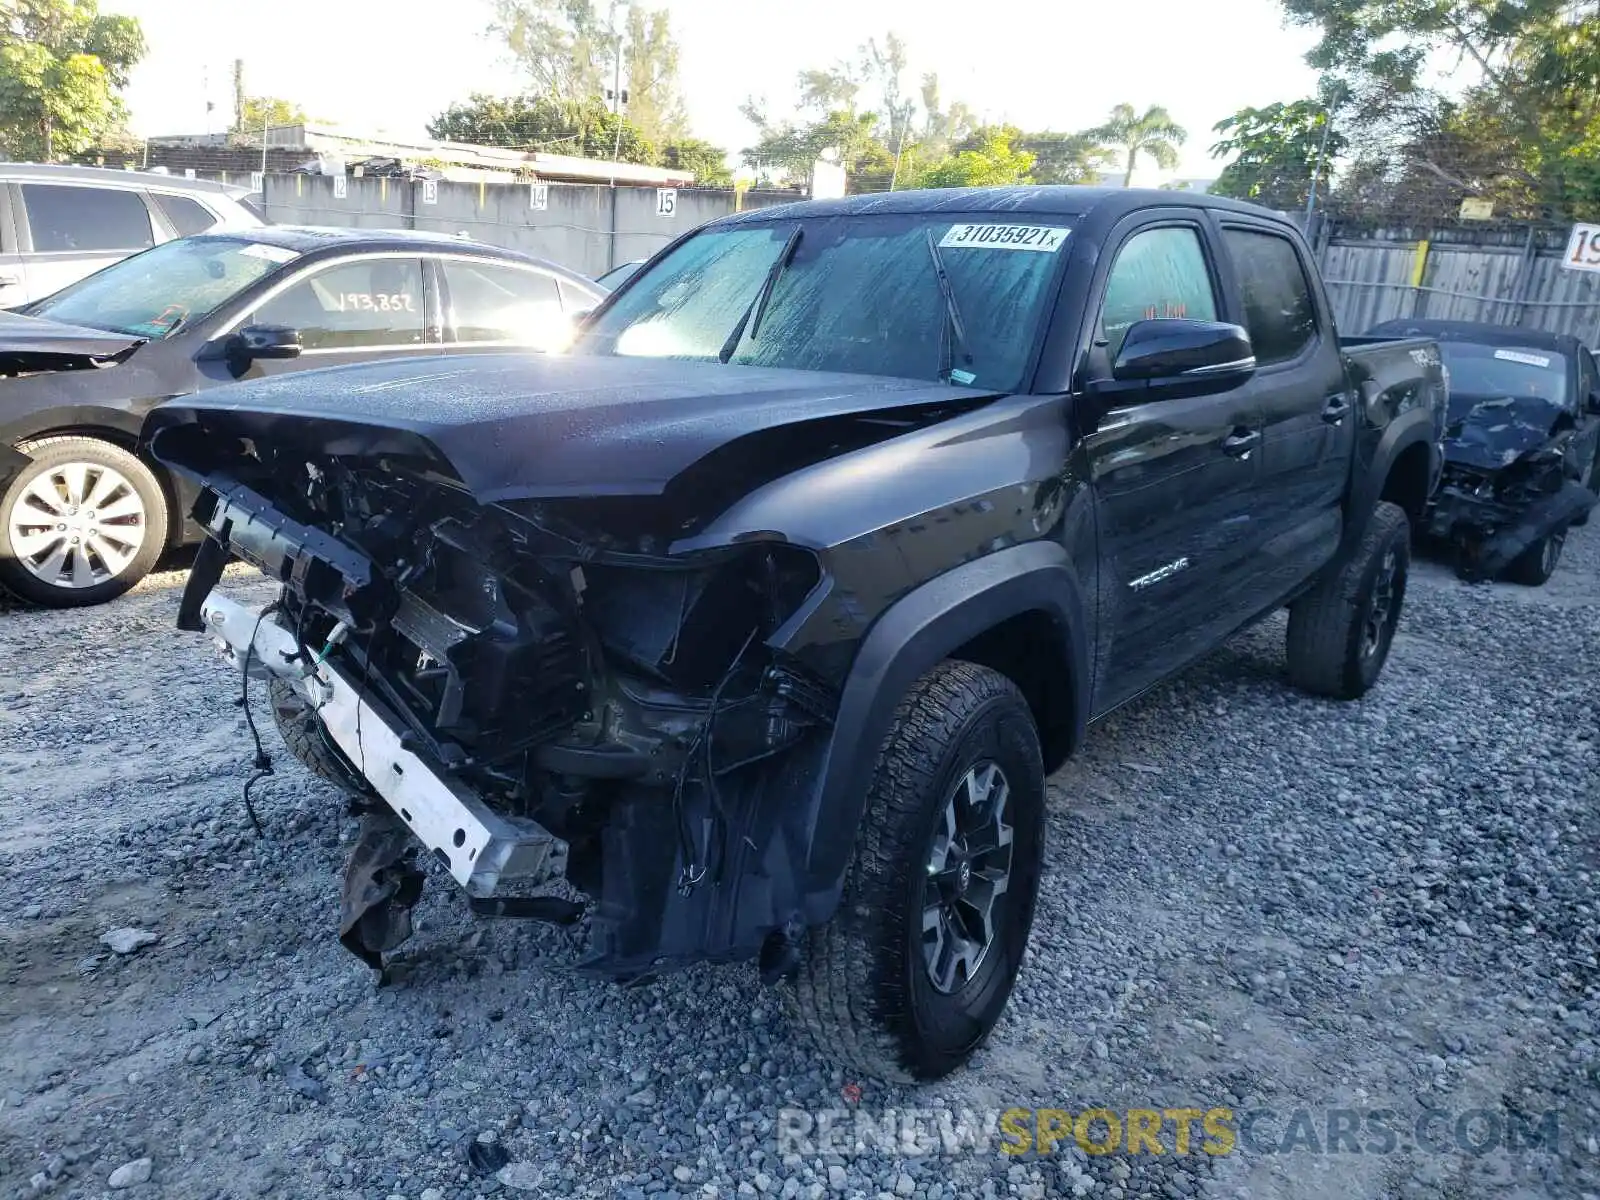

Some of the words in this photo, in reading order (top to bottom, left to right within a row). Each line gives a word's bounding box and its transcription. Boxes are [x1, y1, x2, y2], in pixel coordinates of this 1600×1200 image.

[335, 178, 346, 195] 12
[424, 182, 436, 201] 13
[532, 187, 546, 207] 14
[658, 191, 674, 214] 15
